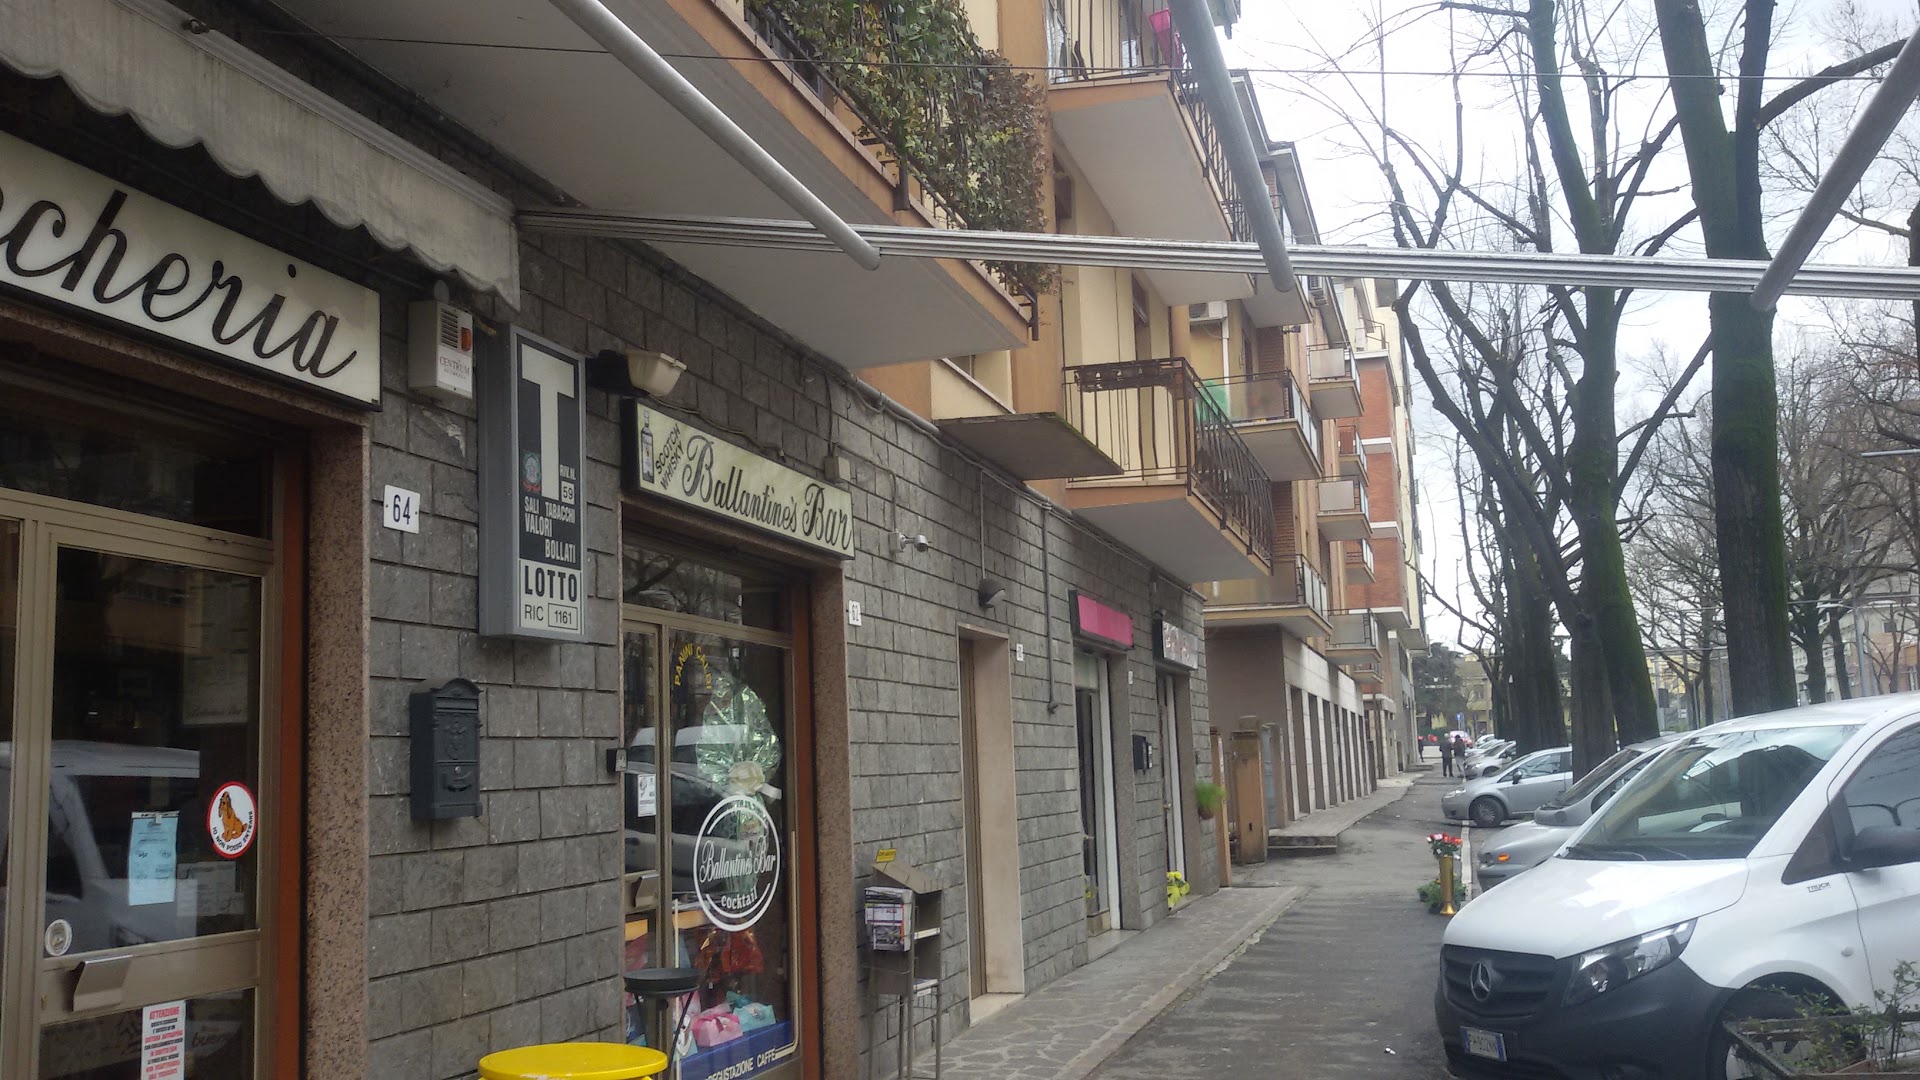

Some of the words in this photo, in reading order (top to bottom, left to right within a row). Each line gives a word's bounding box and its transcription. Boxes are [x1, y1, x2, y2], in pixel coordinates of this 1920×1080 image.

[0, 189, 358, 379] cheria
[655, 422, 682, 475] SCOTCH
[660, 440, 685, 491] WHISKY
[563, 486, 574, 499] 59
[682, 434, 798, 533] Ballantine's
[802, 483, 852, 550] Bar
[393, 494, 411, 525] 64
[524, 496, 540, 513] SALI
[545, 501, 576, 524] TABACCHI
[524, 512, 553, 538] VALORI
[544, 538, 576, 564] BOLLATI
[524, 565, 578, 602] LOTTO
[524, 604, 544, 622] RIC
[554, 610, 572, 625] 1161
[674, 643, 694, 686] PANINI
[753, 835, 776, 874] Bar
[721, 885, 758, 910] cocktail
